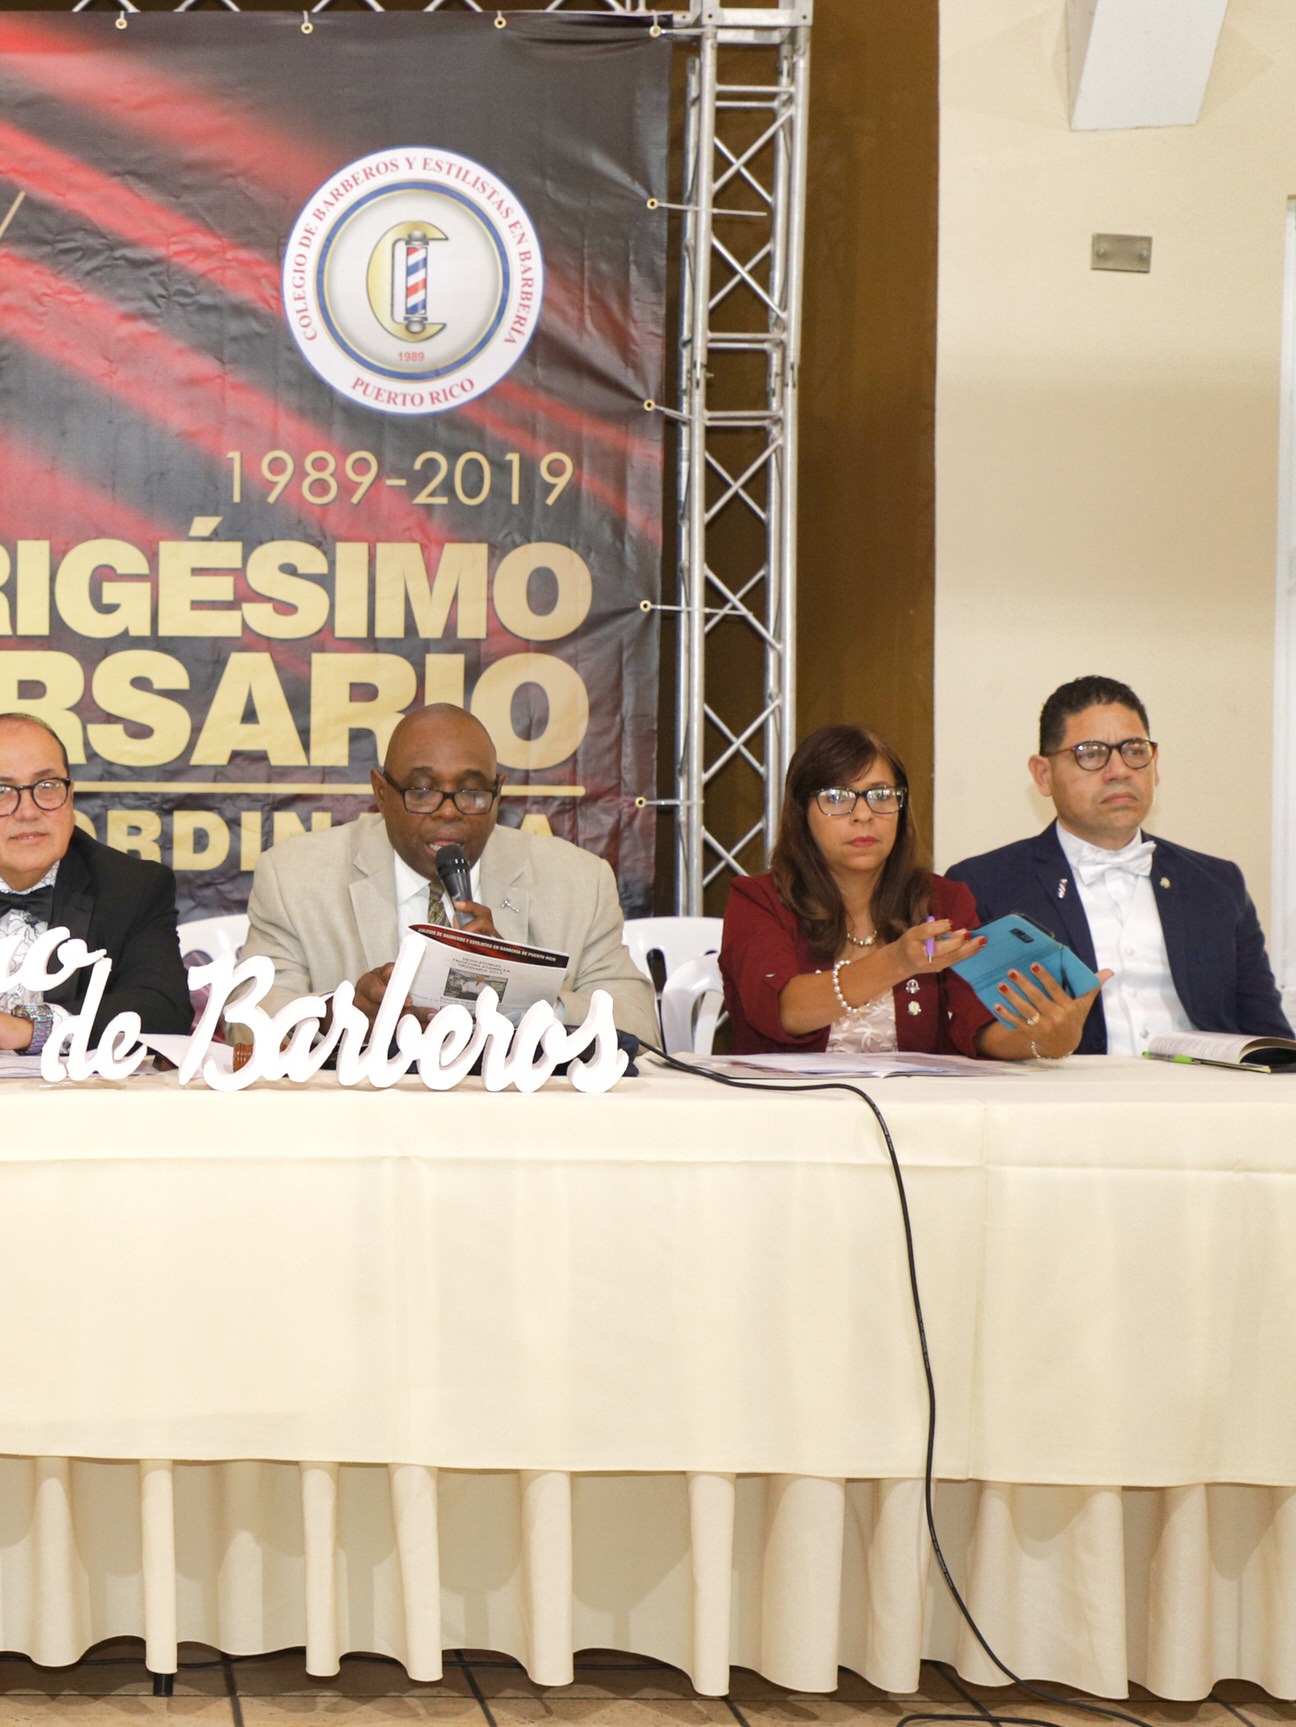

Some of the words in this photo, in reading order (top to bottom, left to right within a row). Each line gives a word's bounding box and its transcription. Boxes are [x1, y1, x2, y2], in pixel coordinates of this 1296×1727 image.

[312, 157, 400, 222] BARBEROS
[404, 157, 417, 170] Y
[421, 157, 514, 220] ESTILISTAS
[298, 223, 319, 250] DE
[507, 220, 529, 246] EN
[292, 253, 318, 342] COLEGIO
[504, 250, 535, 345] BARBERÍA
[398, 352, 425, 362] 1989
[351, 376, 424, 407] PUERTO
[429, 377, 475, 406] RICO
[226, 449, 574, 507] 1989-2019
[41, 956, 149, 1083] de
[178, 934, 630, 1093] Barberos
